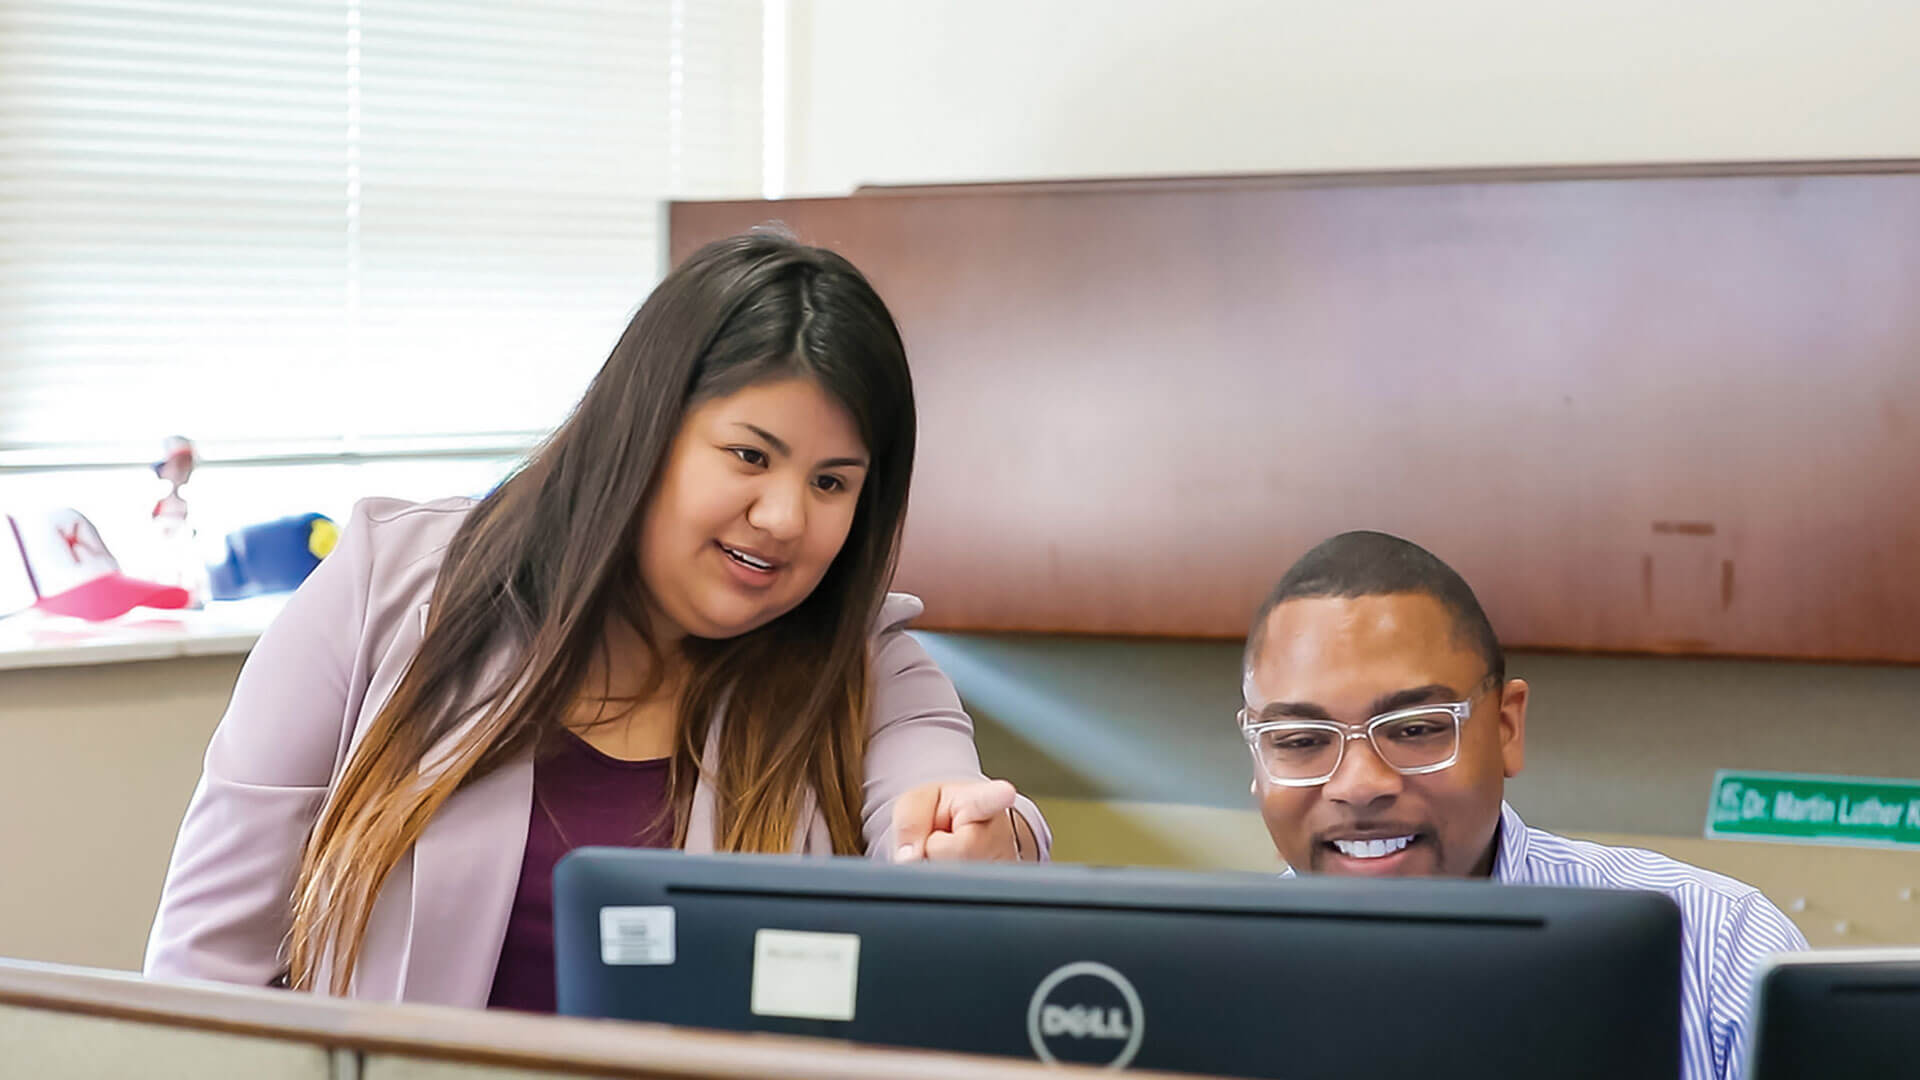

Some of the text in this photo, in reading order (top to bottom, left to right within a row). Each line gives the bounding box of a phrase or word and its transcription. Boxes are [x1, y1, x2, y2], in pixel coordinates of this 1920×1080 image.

[1773, 790, 1836, 822] Martin
[1838, 794, 1903, 826] Luther
[1042, 1004, 1129, 1039] DELL
